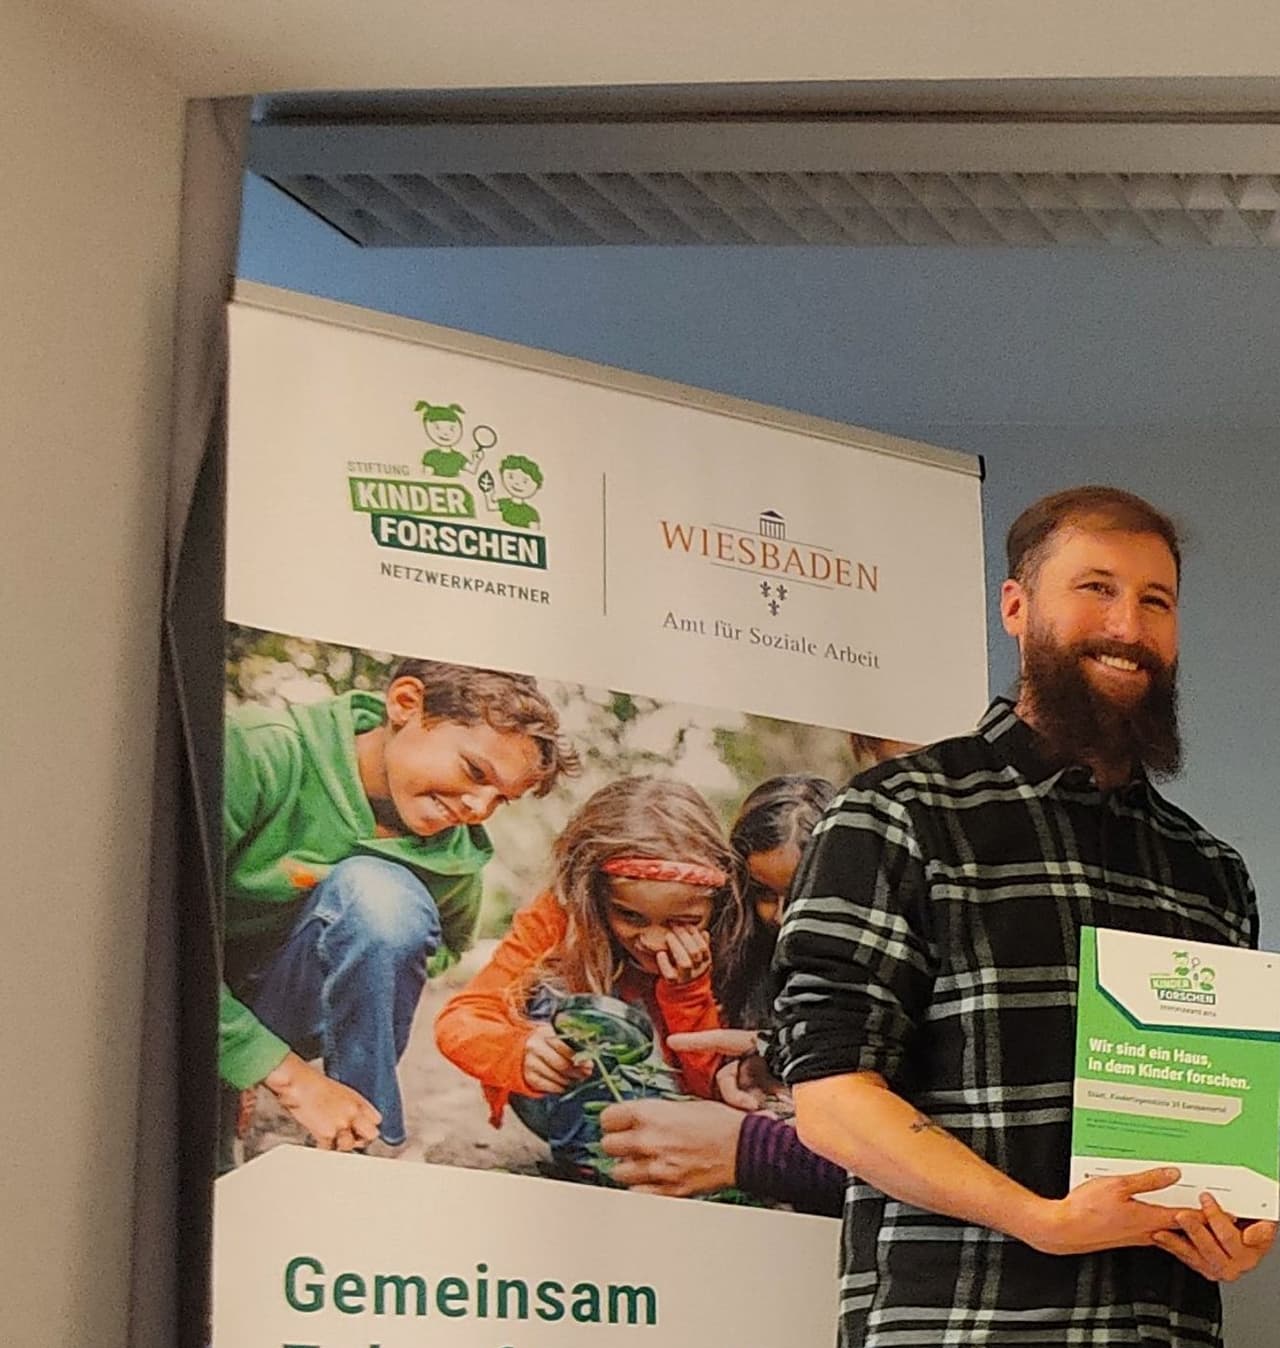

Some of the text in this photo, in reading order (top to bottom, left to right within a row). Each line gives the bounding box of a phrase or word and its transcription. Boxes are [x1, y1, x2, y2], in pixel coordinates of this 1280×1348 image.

[348, 461, 410, 476] STIFTUNG
[357, 482, 468, 514] KINDER
[379, 517, 539, 564] FORSCHEN
[661, 520, 879, 592] WIESBADEN
[380, 562, 550, 604] NETZWERKPARTNER
[663, 611, 880, 669] Amt für Soziale Arbeit
[1089, 1038, 1212, 1068] Wir sind ein Haus,
[1105, 1059, 1136, 1076] dem
[1138, 1063, 1184, 1081] Kinder
[1186, 1069, 1250, 1090] forschen.
[284, 1256, 657, 1326] Gemeinsam
